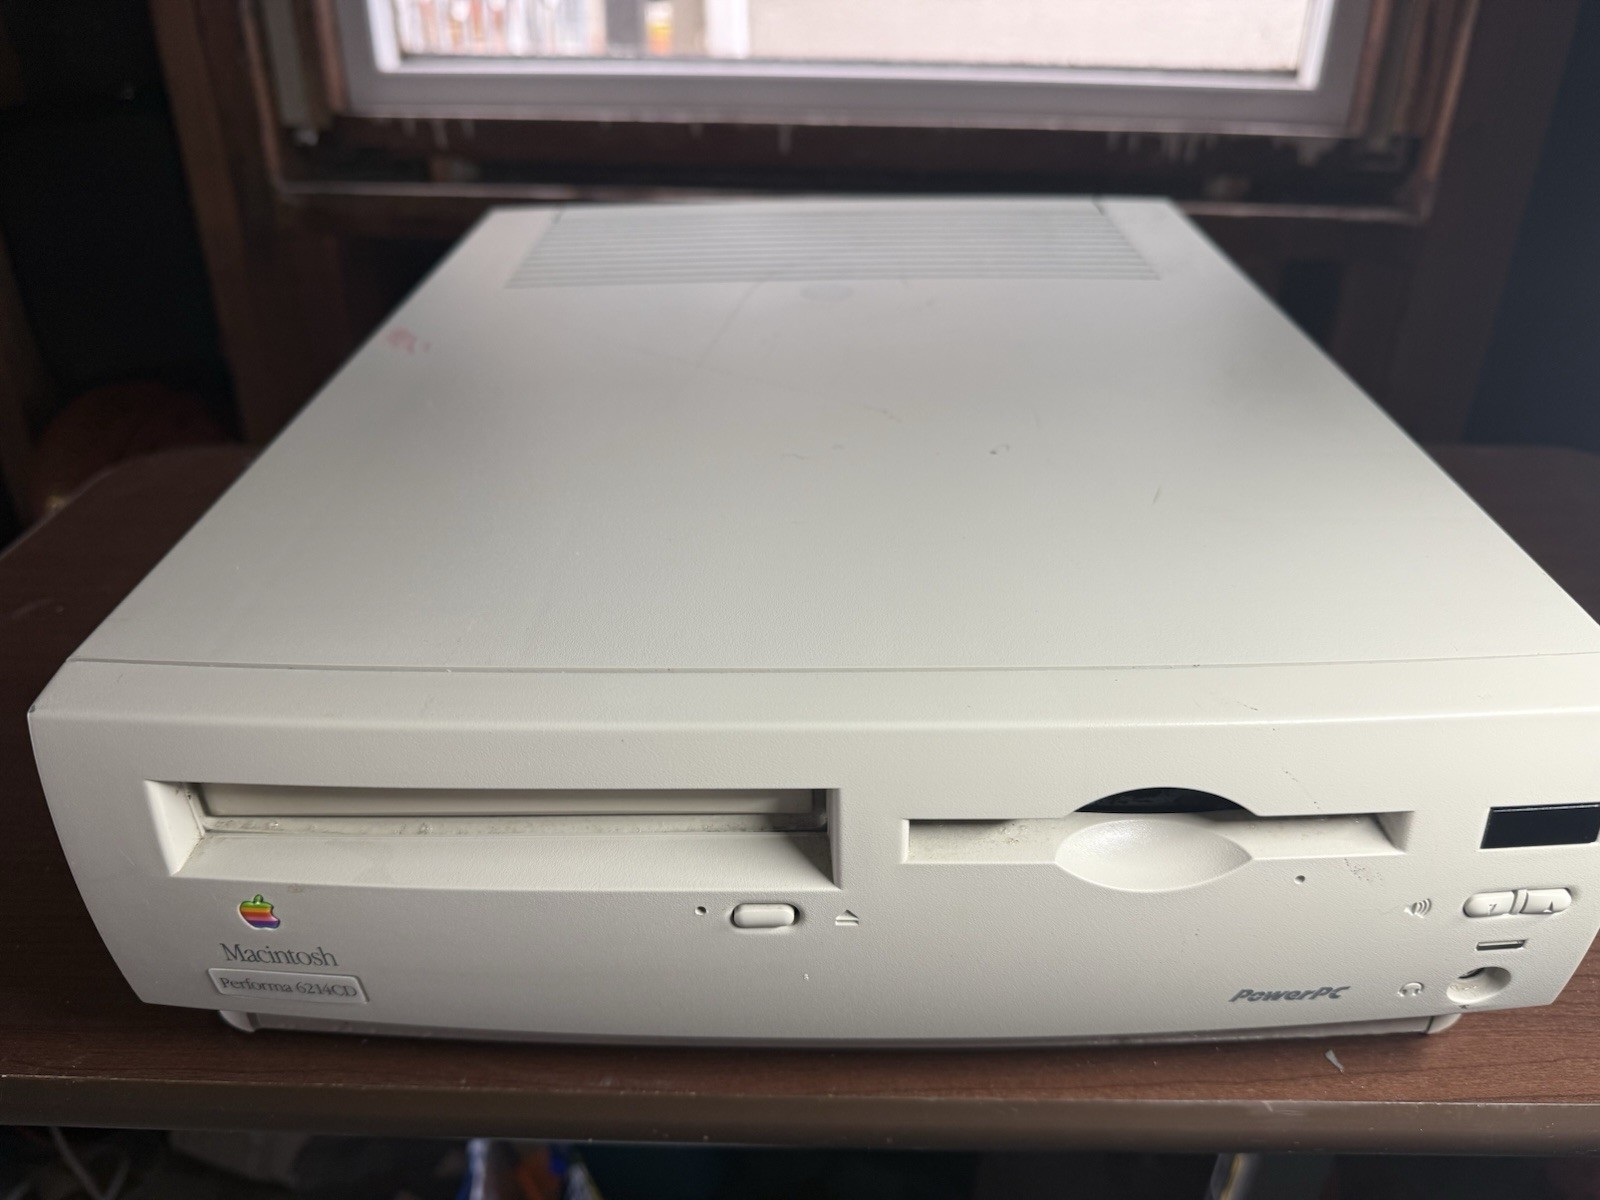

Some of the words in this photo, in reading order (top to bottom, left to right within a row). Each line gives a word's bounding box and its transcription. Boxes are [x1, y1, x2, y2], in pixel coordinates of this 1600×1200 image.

[219, 942, 339, 967] Macintosh
[219, 977, 294, 993] Performa
[296, 981, 358, 997] 6214CD
[1228, 986, 1351, 1002] PowerPC
